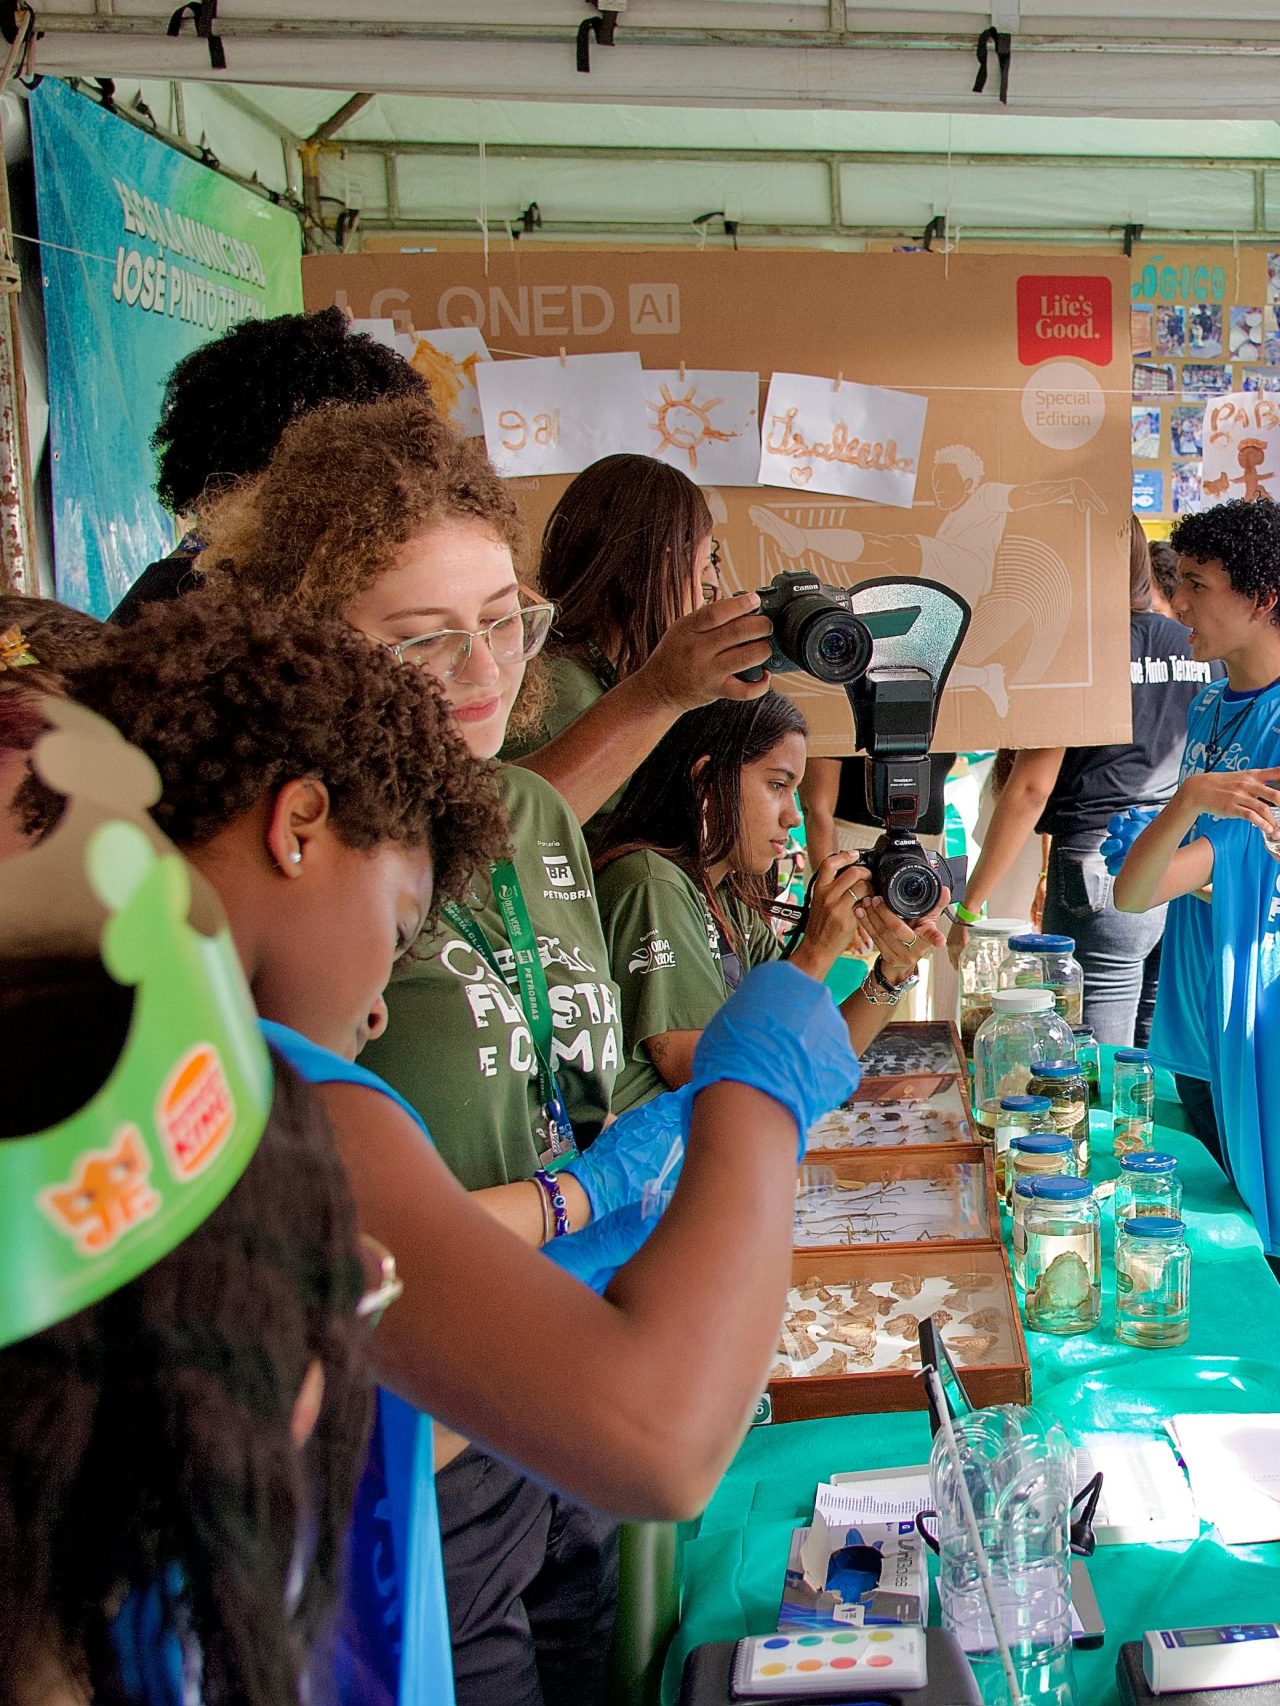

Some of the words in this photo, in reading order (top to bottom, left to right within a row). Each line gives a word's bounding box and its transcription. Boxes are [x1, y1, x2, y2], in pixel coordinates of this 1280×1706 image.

[112, 246, 168, 316] JOSÉ
[168, 265, 219, 331] PINTO
[437, 286, 615, 336] QNED
[636, 293, 674, 324] AI
[1040, 295, 1093, 317] Life's
[1035, 318, 1100, 339] Good.
[1036, 391, 1090, 408] Special
[1036, 411, 1091, 426] Edition
[793, 584, 819, 592] Canon
[549, 867, 569, 879] BR
[543, 889, 593, 901] PETROBRA
[524, 967, 540, 1021] PETROBRAS
